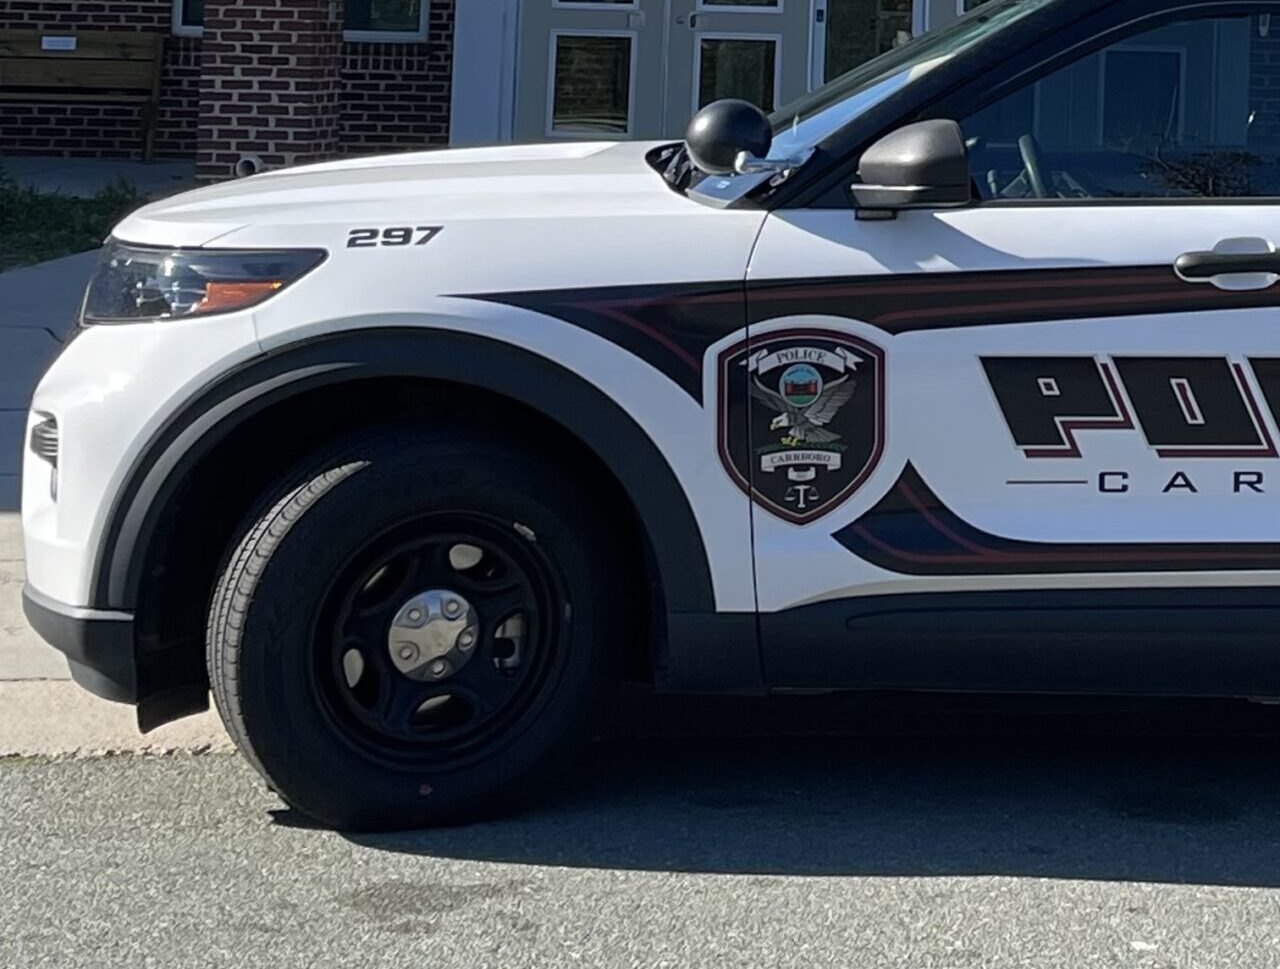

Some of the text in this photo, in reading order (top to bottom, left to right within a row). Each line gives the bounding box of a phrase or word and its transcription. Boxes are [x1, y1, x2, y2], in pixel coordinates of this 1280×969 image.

[346, 225, 445, 248] 297
[776, 348, 827, 364] POLICE
[769, 453, 832, 464] CARRBORO
